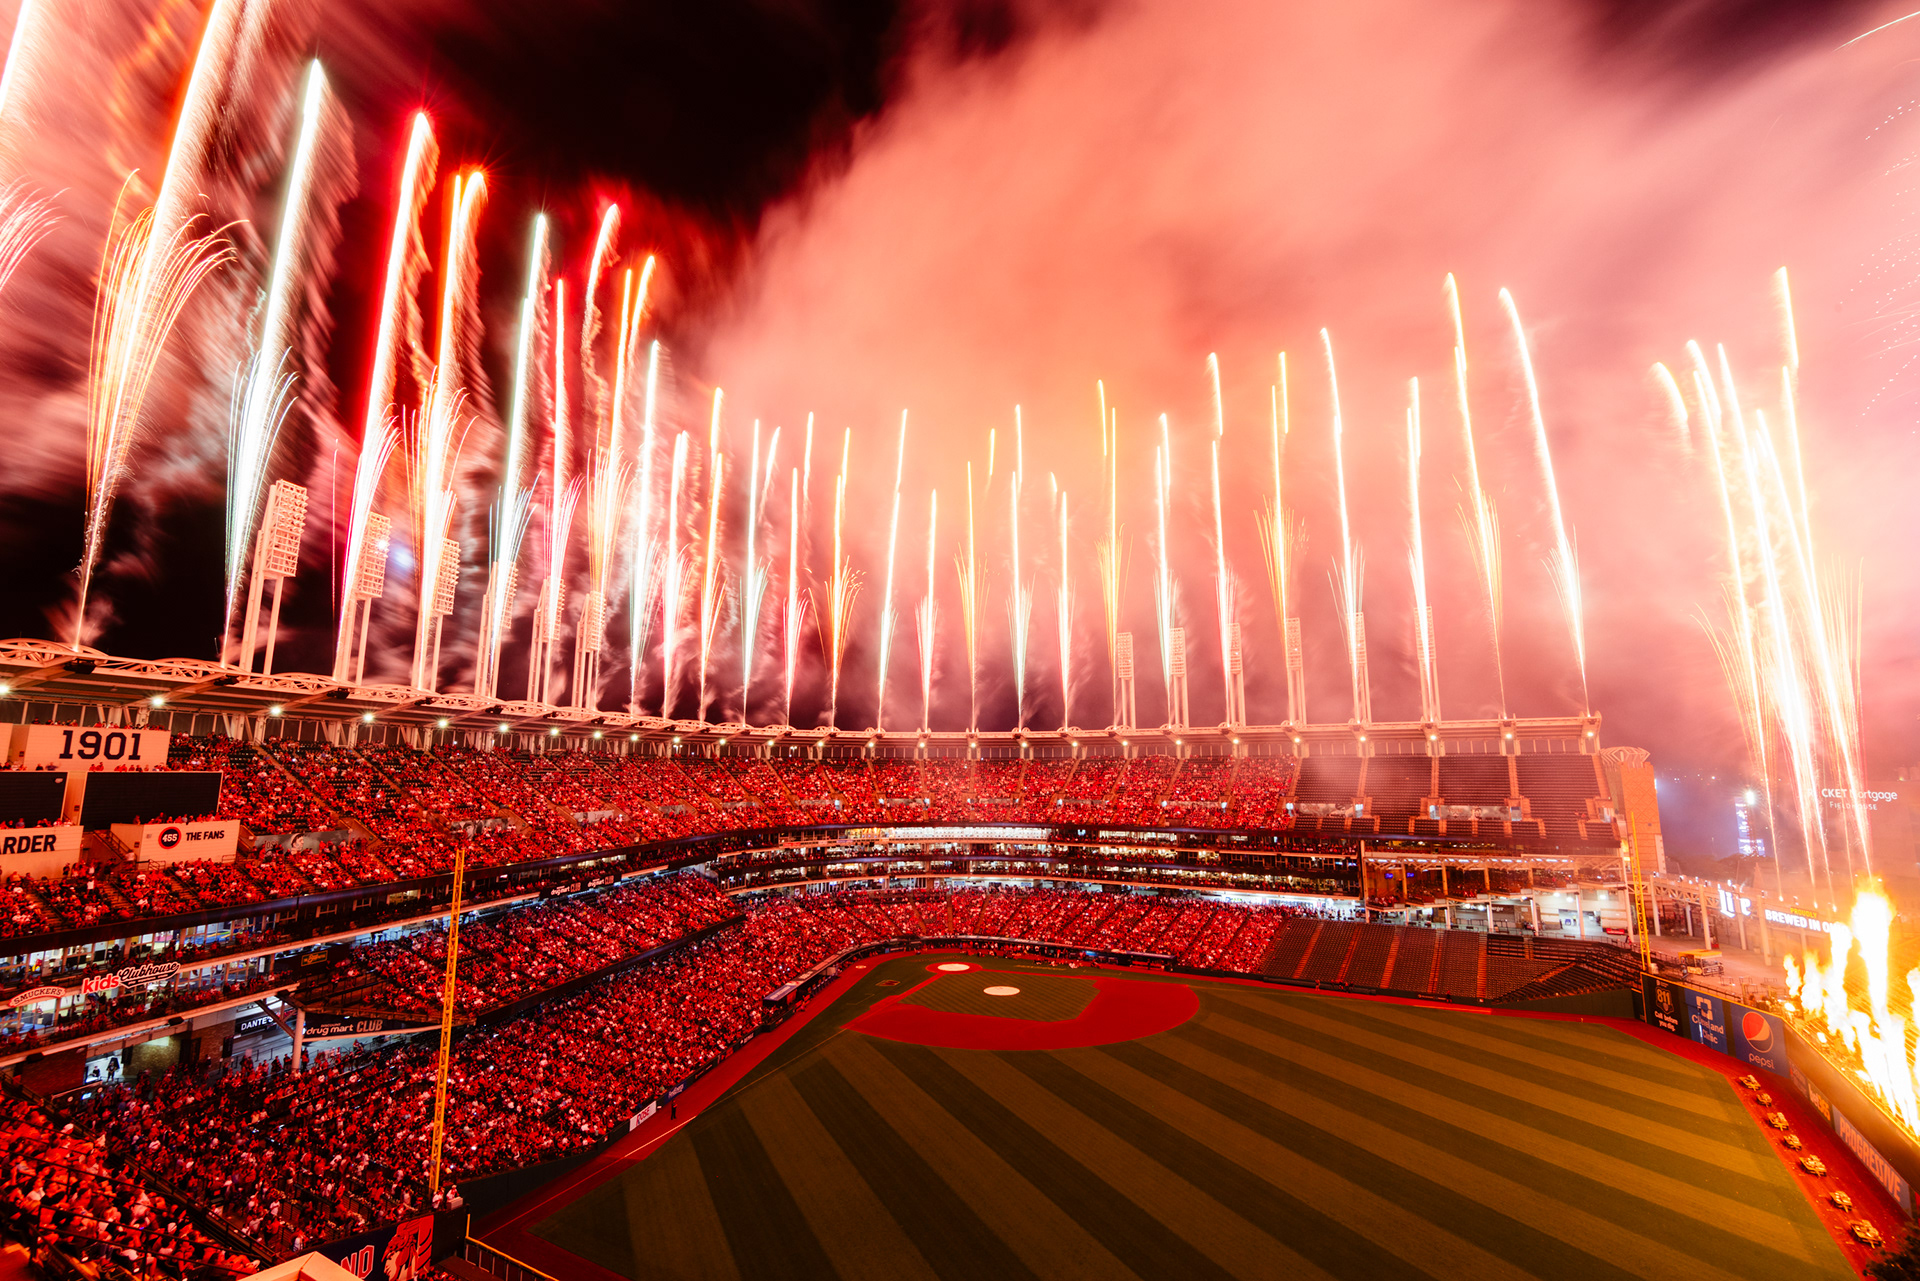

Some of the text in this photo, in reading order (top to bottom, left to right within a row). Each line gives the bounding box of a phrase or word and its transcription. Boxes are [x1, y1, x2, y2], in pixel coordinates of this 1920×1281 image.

[59, 730, 141, 760] 1901
[1808, 788, 1847, 798] RCKET
[0, 834, 57, 855] RDER
[162, 830, 225, 843] 455 THE FANS
[1718, 880, 1752, 918] Lie
[1765, 909, 1808, 928] BREWED
[1809, 919, 1821, 932] IN
[1790, 907, 1818, 919] PROUDLY
[83, 962, 180, 994] kids Clubhouse
[13, 988, 63, 1005] SMUCKER'S
[1657, 989, 1671, 1005] 811
[241, 1015, 274, 1031] DANTE'S
[306, 1019, 383, 1036] drug mart CLUB
[1749, 1052, 1775, 1070] pepsi
[1839, 1115, 1901, 1203] PROGRESSIVE
